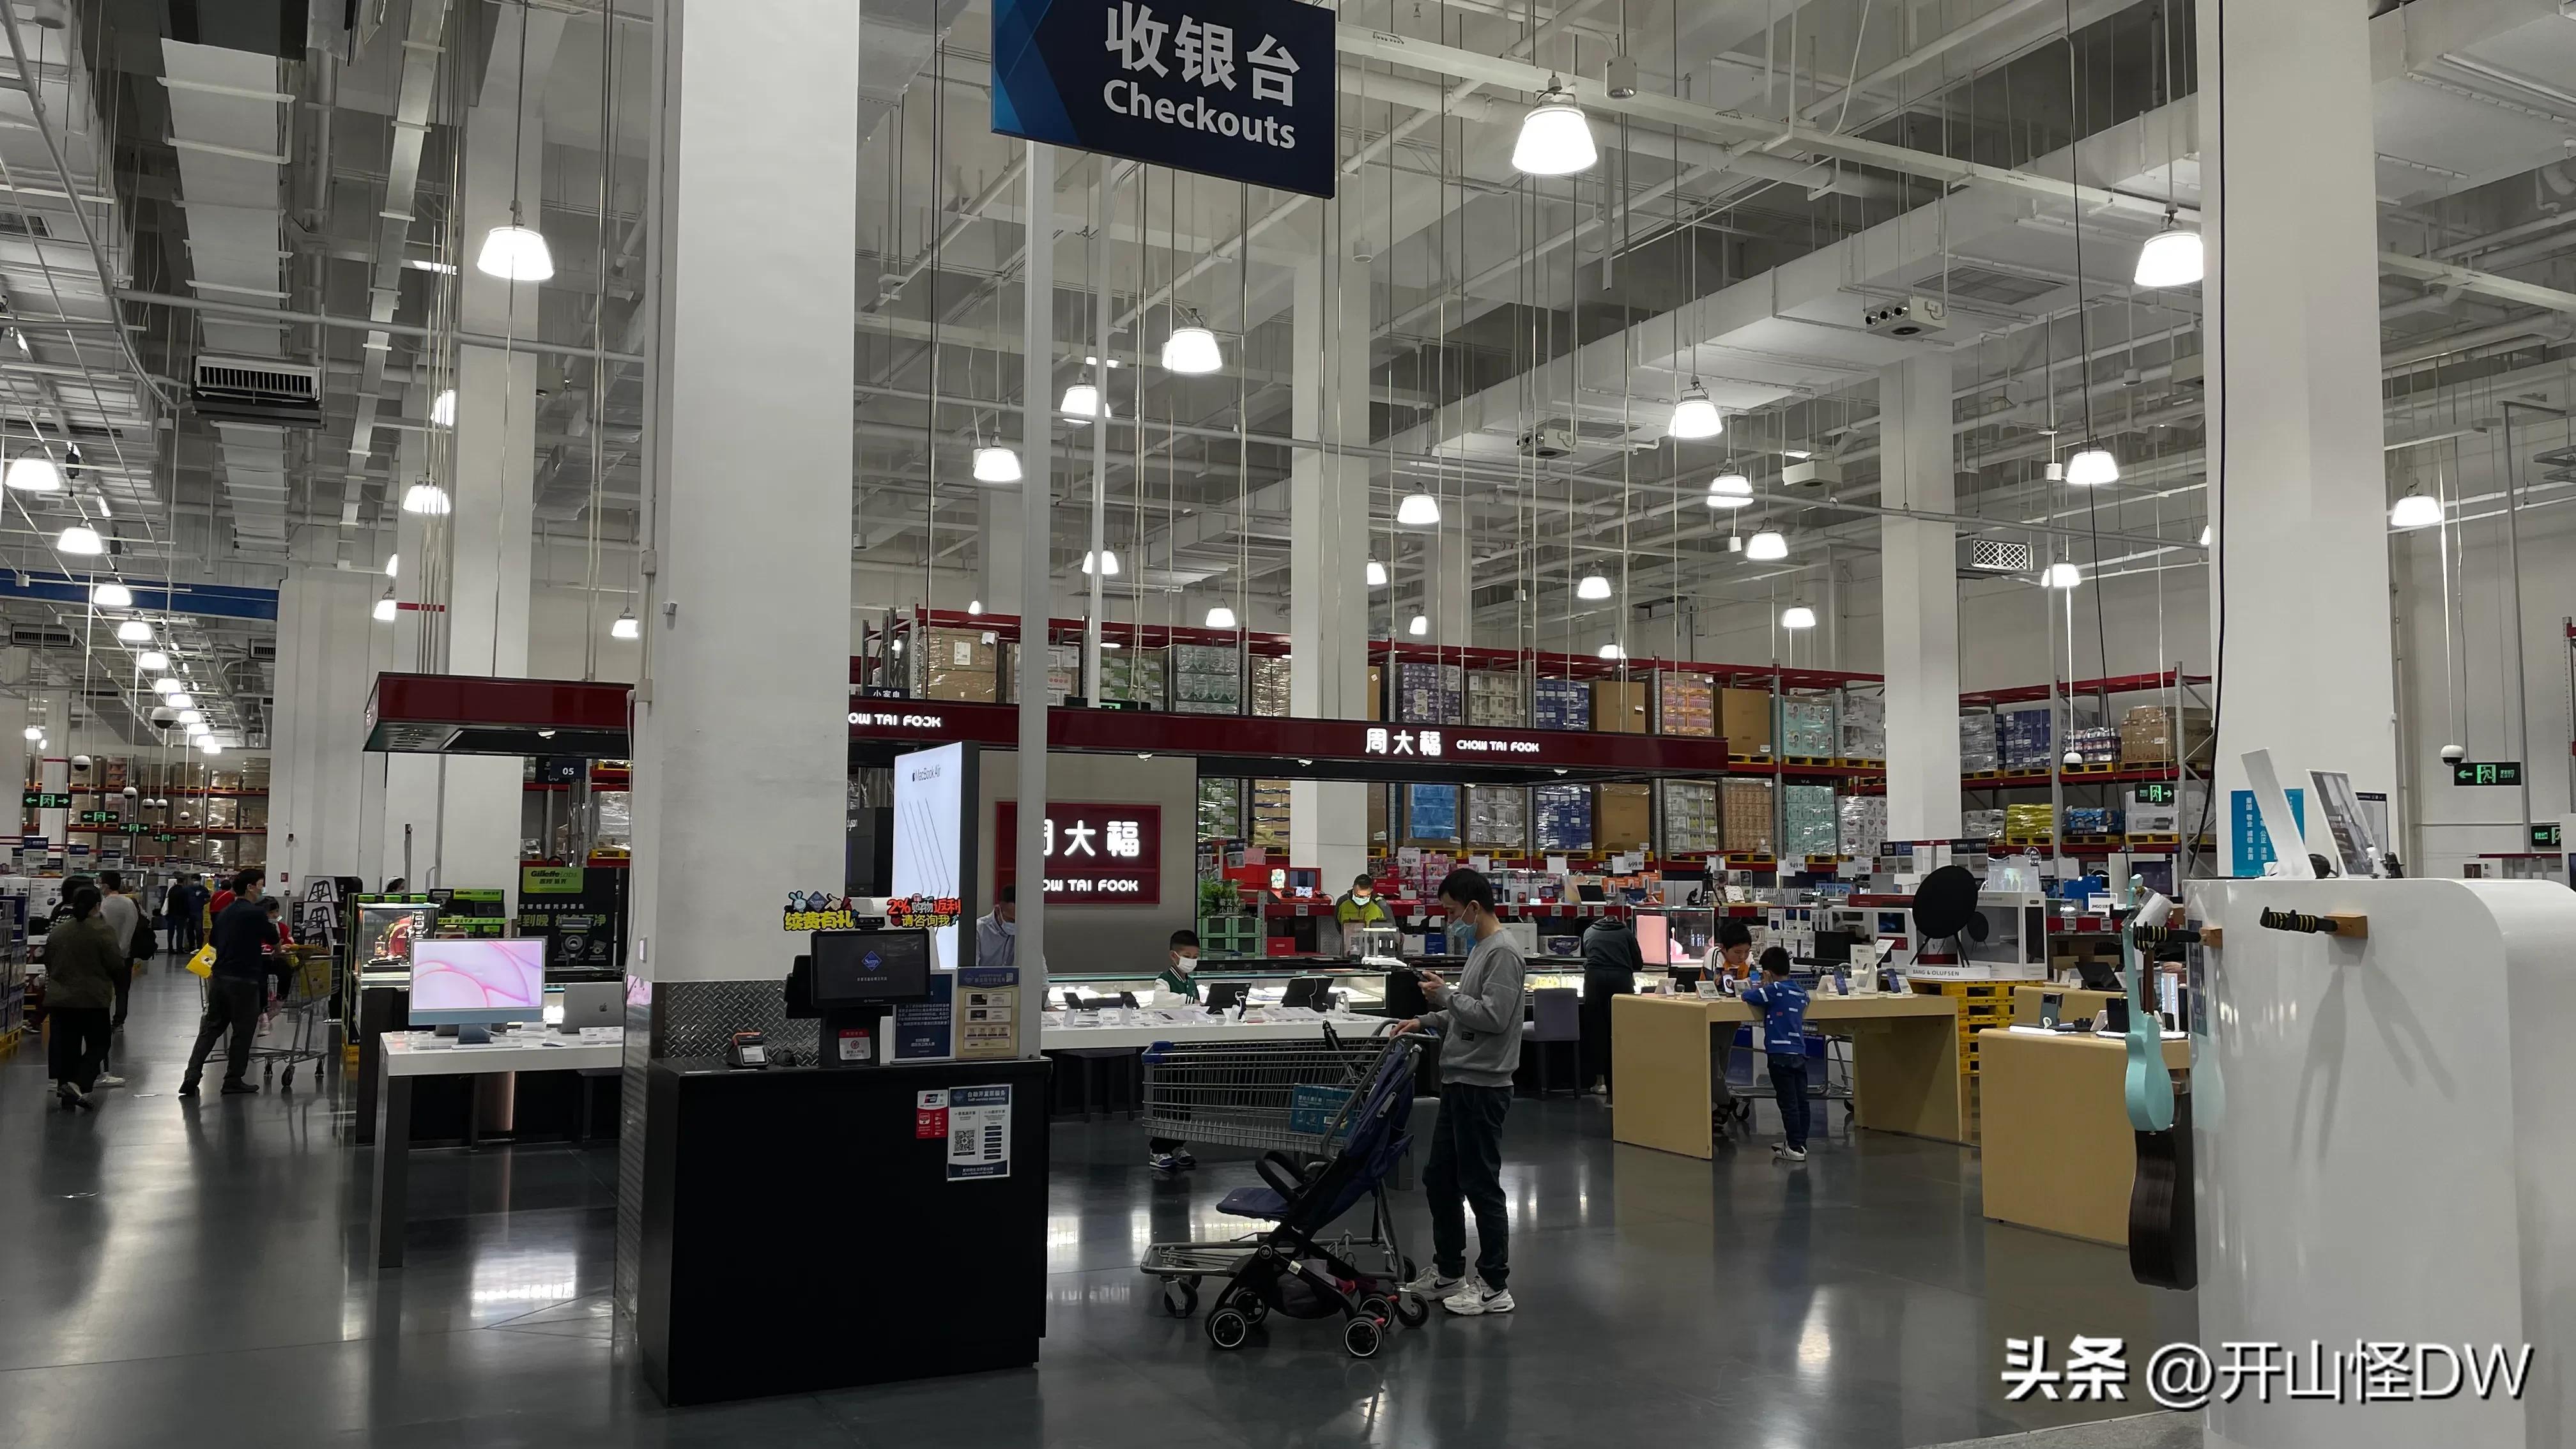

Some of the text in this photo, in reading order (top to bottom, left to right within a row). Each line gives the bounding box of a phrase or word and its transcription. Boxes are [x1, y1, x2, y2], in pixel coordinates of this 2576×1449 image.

[1105, 1, 1300, 107] 收银台
[1103, 79, 1296, 150] Checkouts
[848, 712, 941, 727] OW TAI FOOK
[1365, 728, 1441, 756] 周大福
[1456, 740, 1540, 753] CHOW TAI FOOK
[916, 768, 934, 781] MacBook
[1043, 879, 1138, 891] OW TAI FOOK
[785, 910, 854, 930] 续费有礼
[901, 914, 951, 927] 请咨询我
